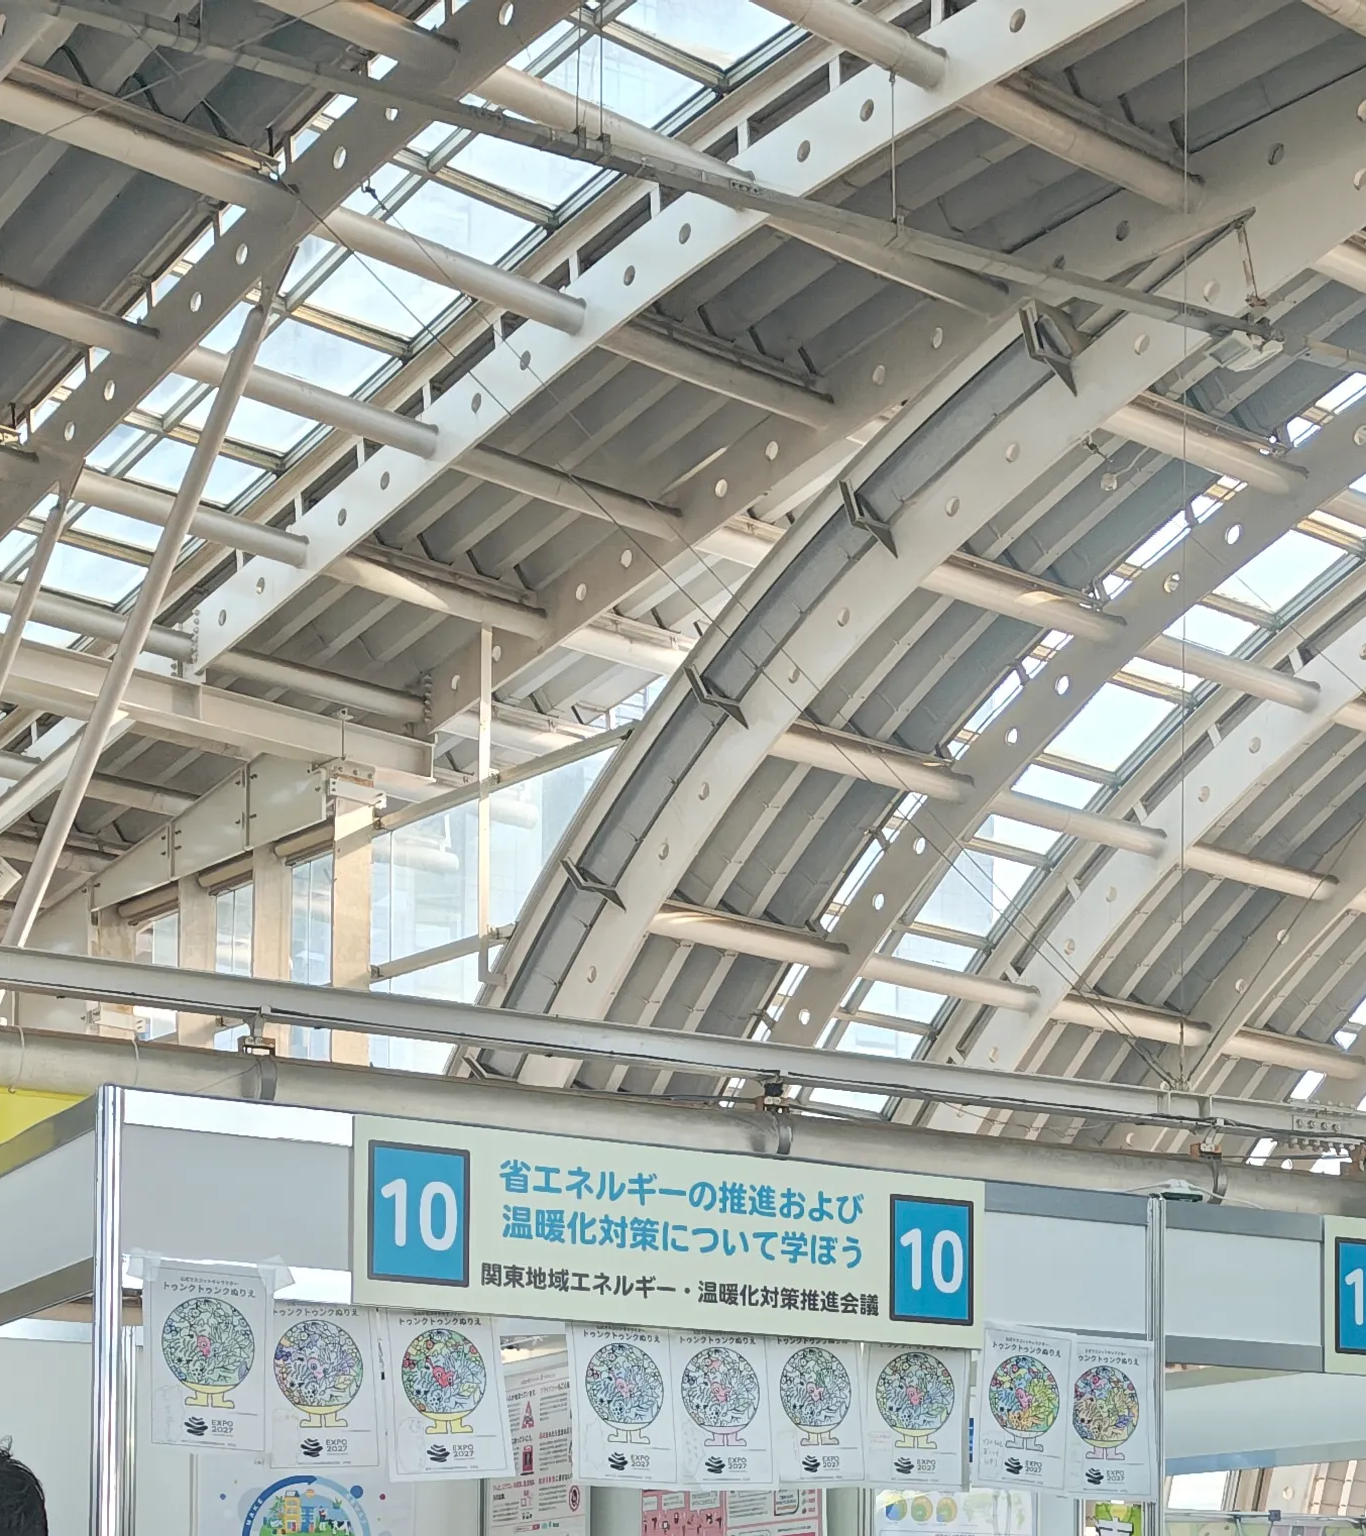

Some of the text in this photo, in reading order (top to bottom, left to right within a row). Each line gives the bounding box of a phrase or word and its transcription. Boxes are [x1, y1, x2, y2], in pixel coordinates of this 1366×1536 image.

[498, 1159, 865, 1223] 省エネルギーの推進および
[380, 1178, 457, 1252] 10
[501, 1204, 864, 1269] 温暖化対策について学ぼう
[899, 1227, 963, 1294] 10
[163, 1281, 256, 1298] トゥンクトゥンクぬりえ
[480, 1262, 881, 1318] 関東地域エネルギー・温暖化対策推進会議
[211, 1419, 233, 1427] EXPO
[452, 1444, 474, 1452] EXPO
[452, 1450, 474, 1458] 2027
[1025, 1460, 1042, 1468] EXPO
